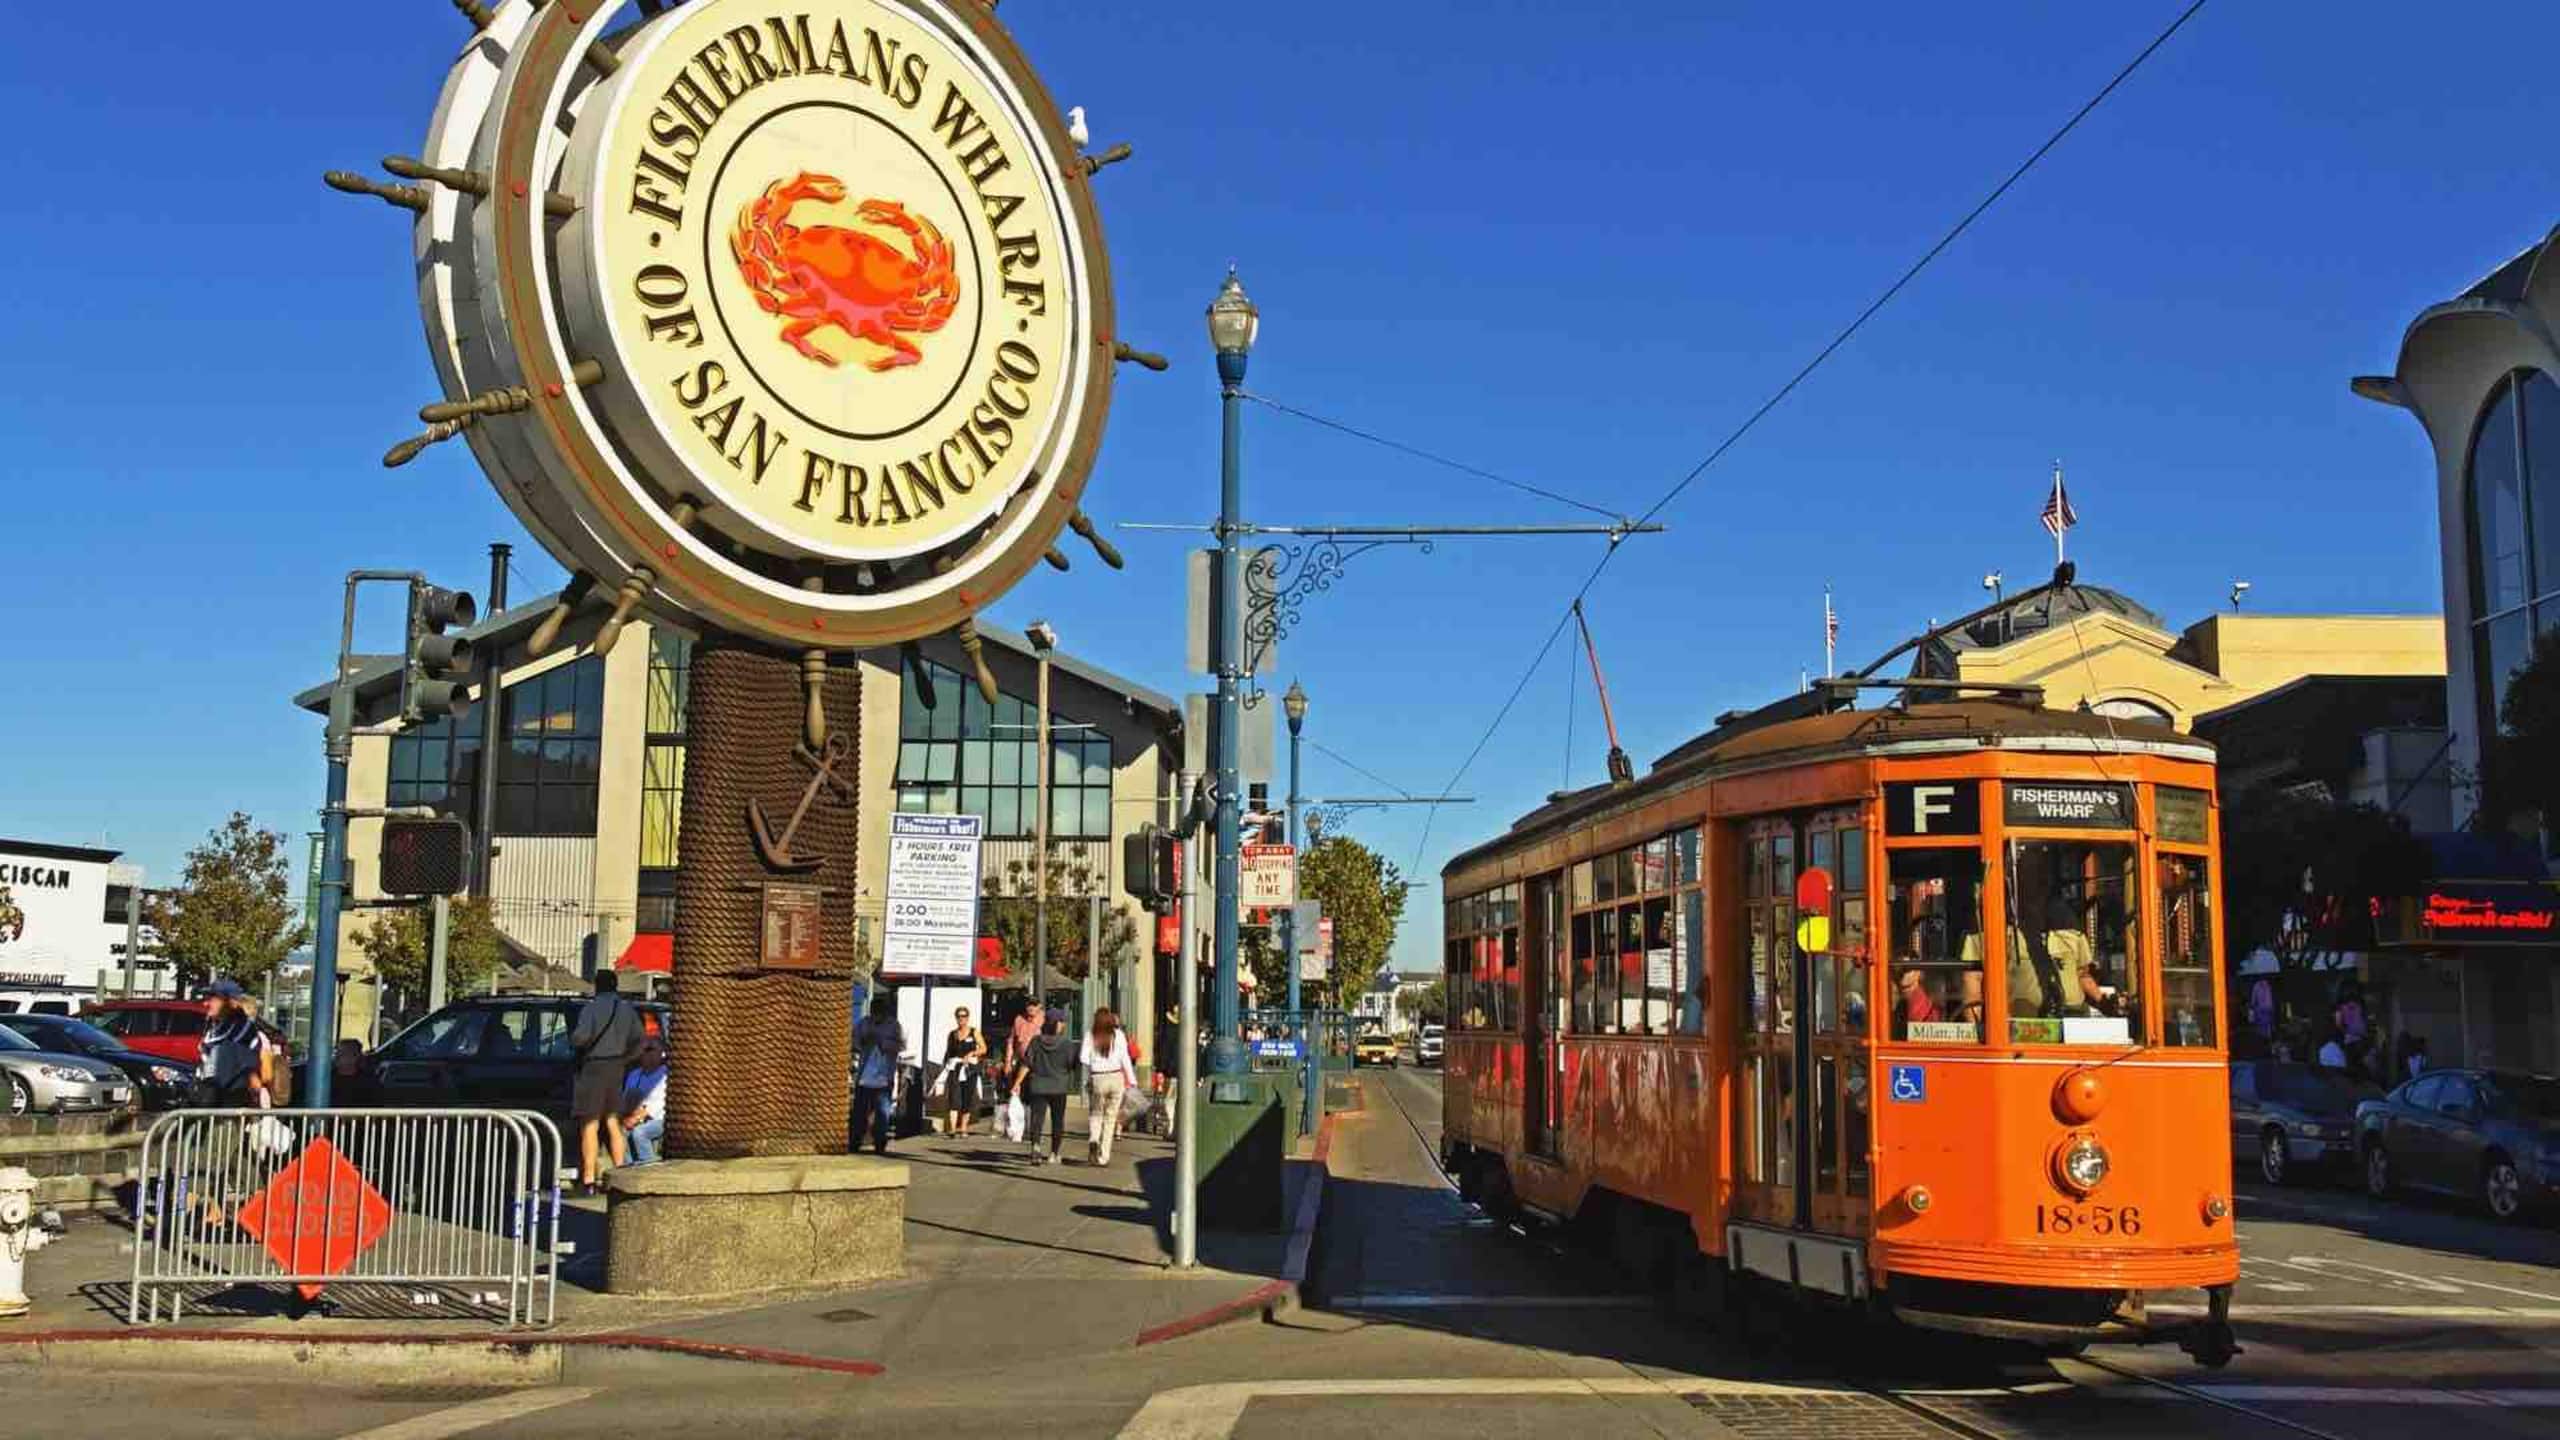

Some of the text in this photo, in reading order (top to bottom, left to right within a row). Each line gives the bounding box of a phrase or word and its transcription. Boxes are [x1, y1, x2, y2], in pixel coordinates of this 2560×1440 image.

[628, 14, 1046, 317] FISHERMANS WHARF
[634, 263, 1041, 528] OF SAN FRANCISCO
[2012, 788, 2119, 805] FISHERMAN'S
[1913, 786, 1955, 833] F
[2037, 803, 2095, 818] WHARF
[910, 852, 958, 862] PARKING
[0, 864, 70, 888] CISCAN
[1257, 872, 1280, 883] ANY
[1255, 885, 1281, 897] TIME
